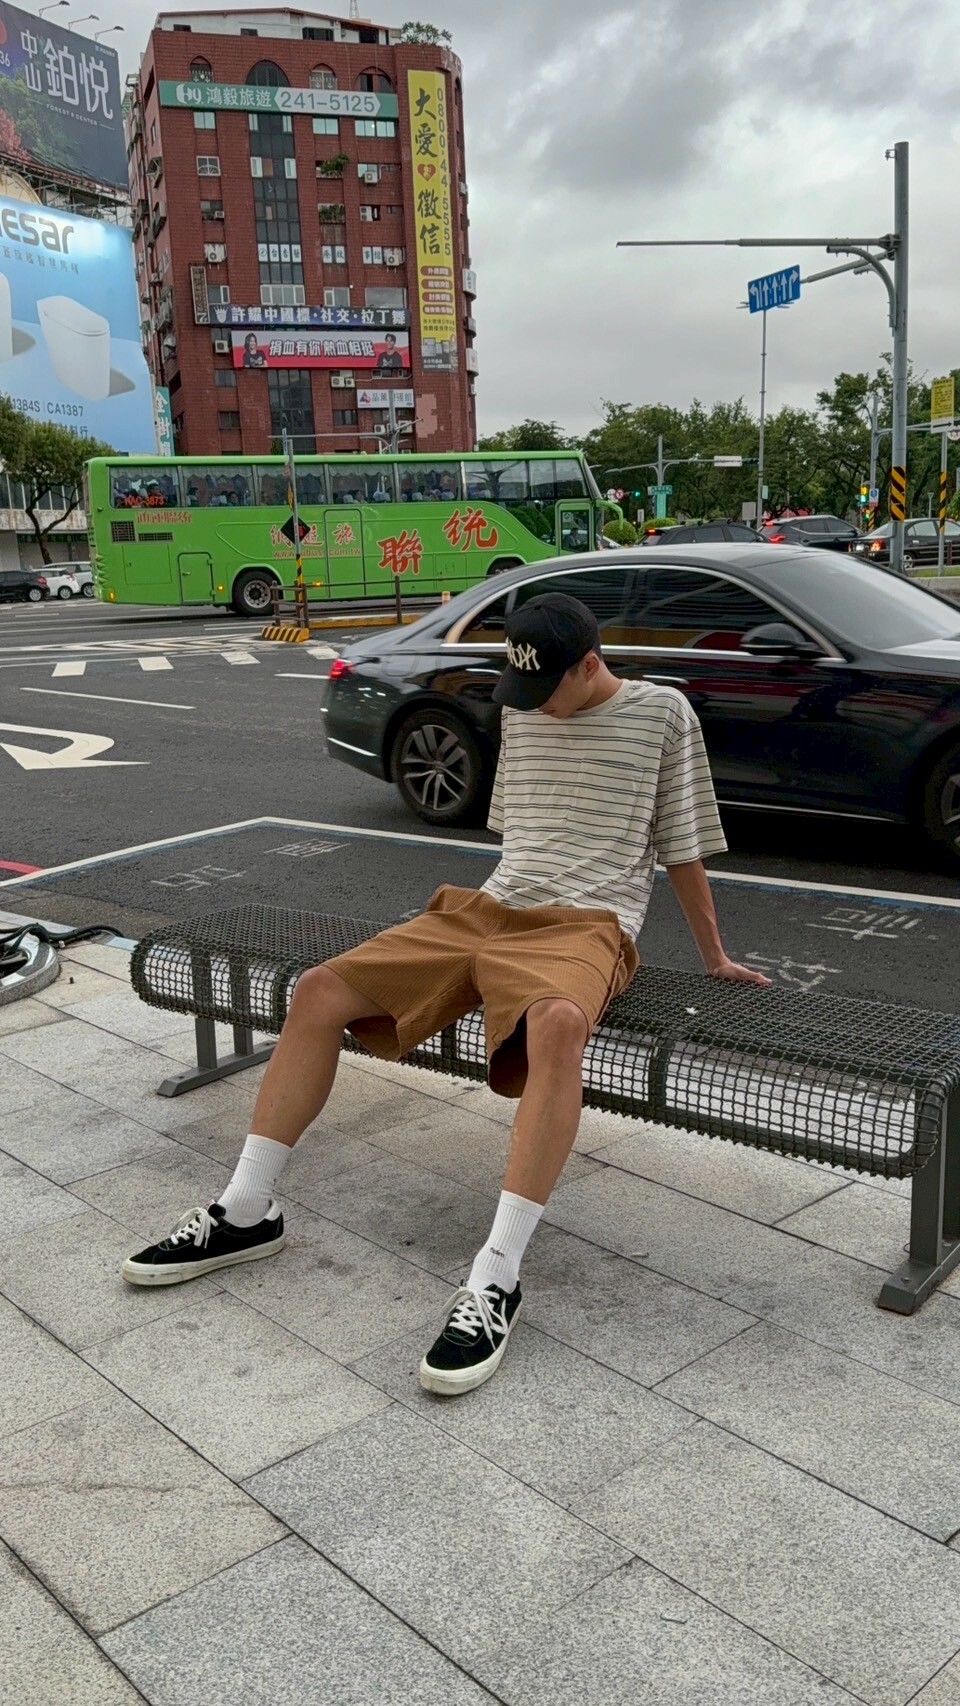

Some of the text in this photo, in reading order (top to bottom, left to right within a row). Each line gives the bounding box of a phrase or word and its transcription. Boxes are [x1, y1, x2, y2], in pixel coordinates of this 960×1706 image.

[21, 29, 42, 92] 中山
[206, 87, 272, 107] 鴻毅旅遊
[280, 91, 375, 113] 241-5125
[46, 103, 69, 116] FOREST
[76, 114, 98, 126] CENTER
[0, 208, 74, 255] esar
[269, 340, 376, 358] 捐血有你 熱血相挺
[47, 402, 84, 417] CA1387
